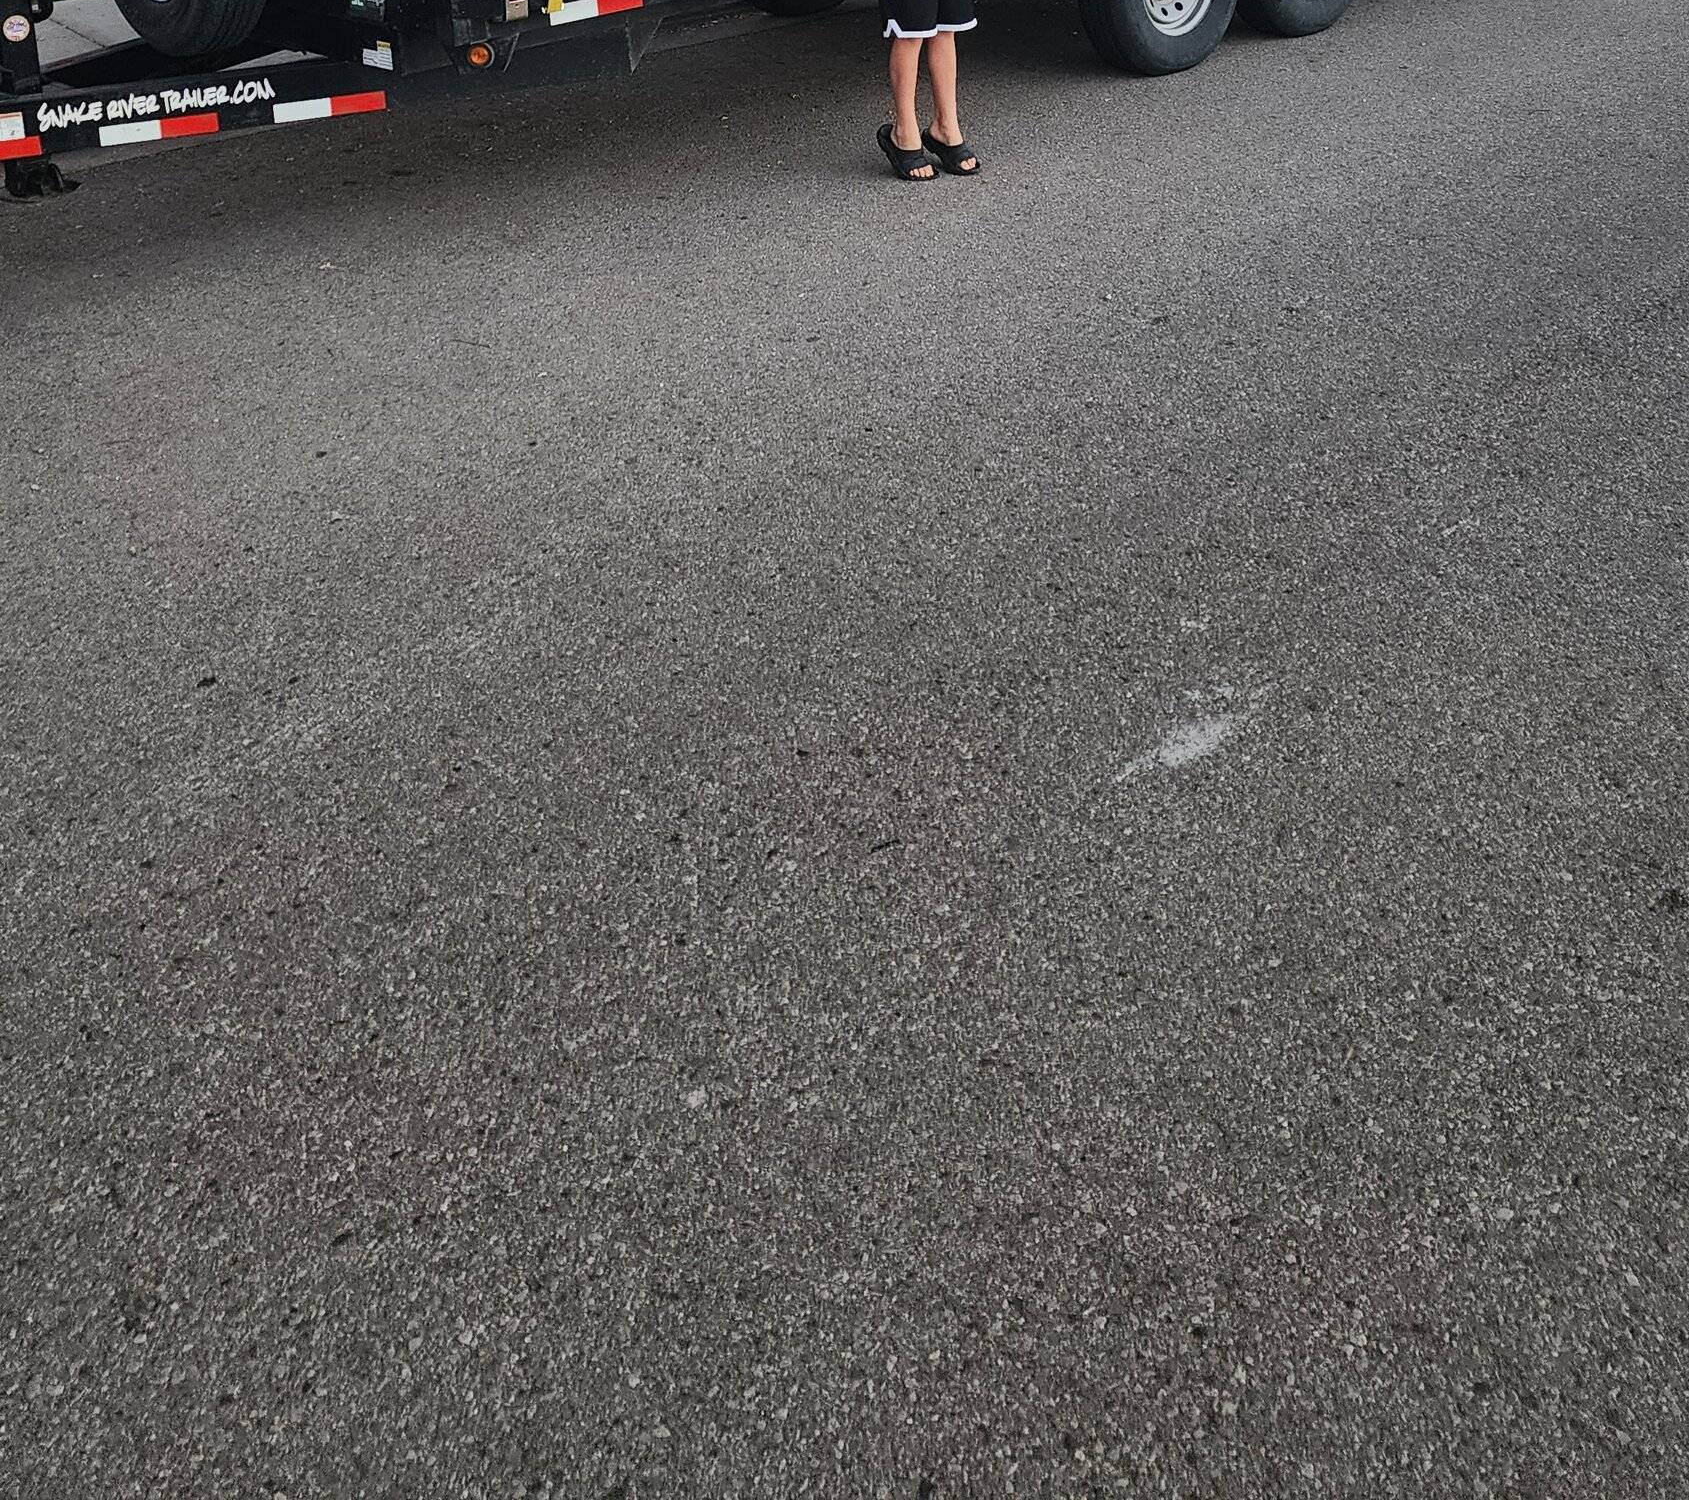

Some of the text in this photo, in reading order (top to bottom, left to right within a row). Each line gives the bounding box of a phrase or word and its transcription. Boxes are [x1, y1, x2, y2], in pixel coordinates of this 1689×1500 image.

[37, 101, 103, 133] SNAKE
[106, 92, 160, 120] RIVER
[160, 78, 276, 114] TRAILER.COM
